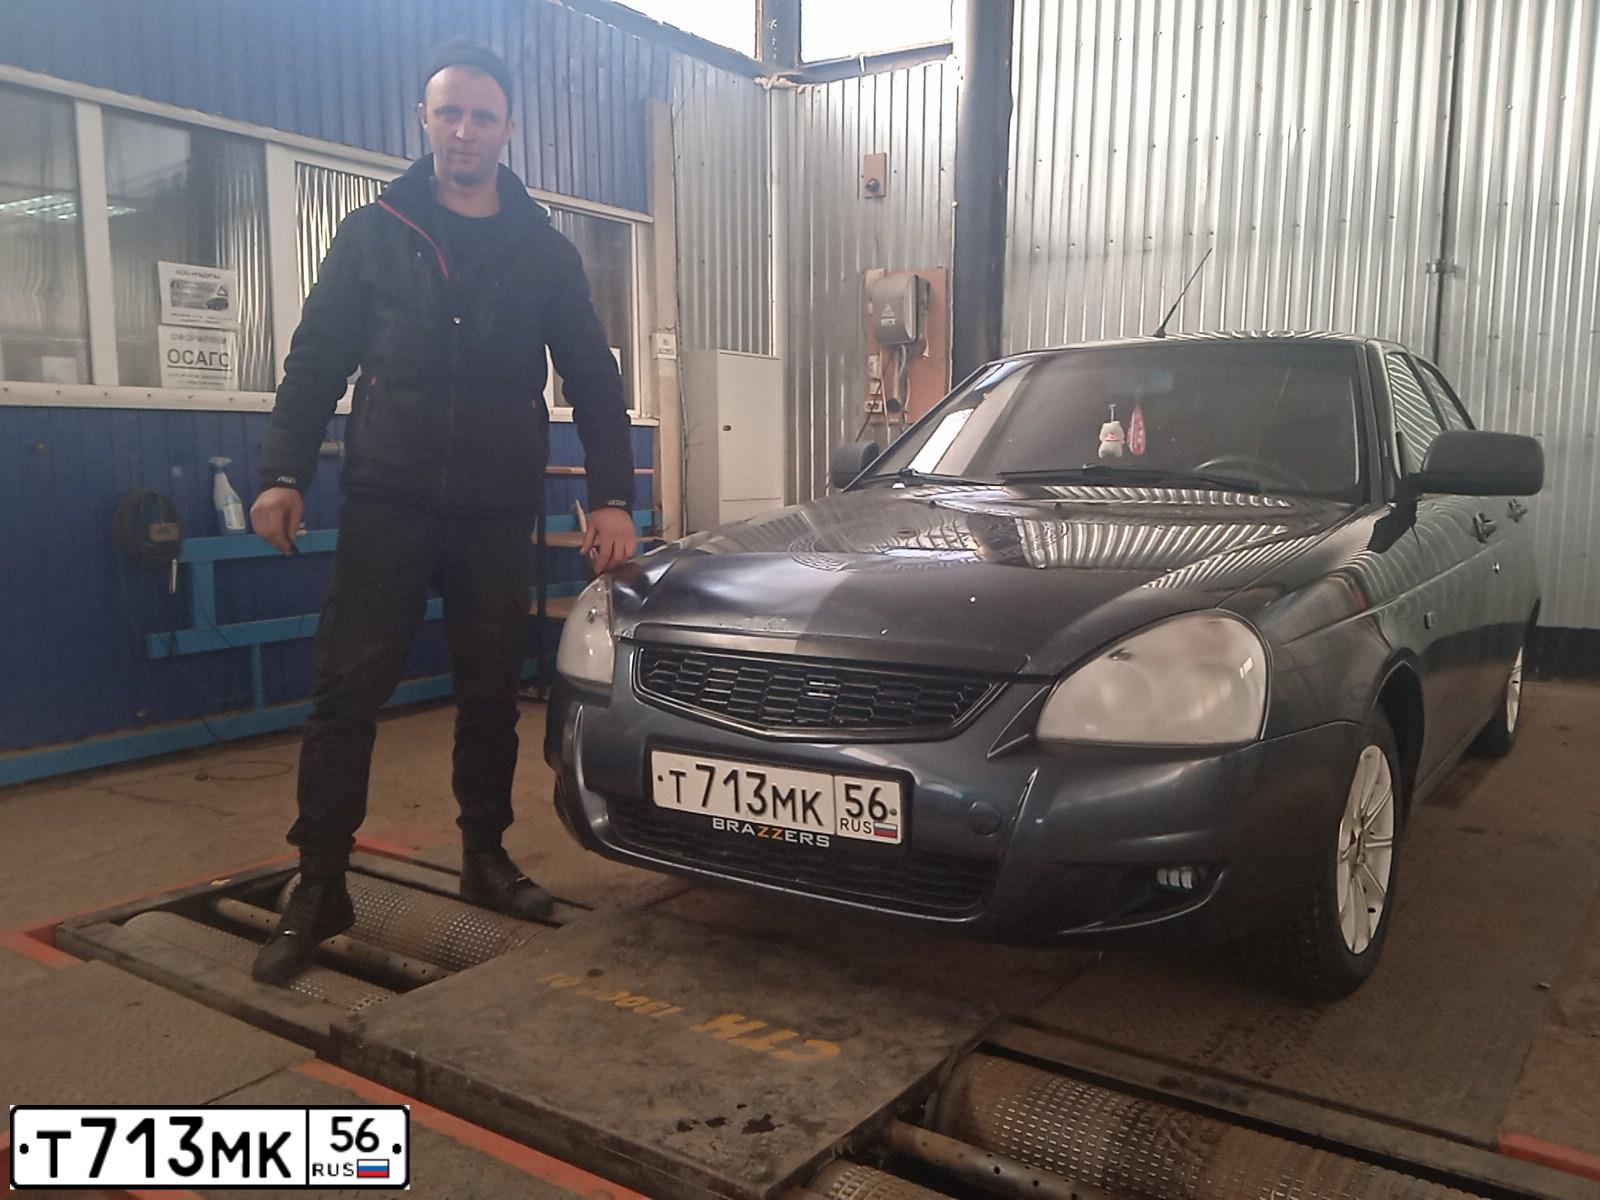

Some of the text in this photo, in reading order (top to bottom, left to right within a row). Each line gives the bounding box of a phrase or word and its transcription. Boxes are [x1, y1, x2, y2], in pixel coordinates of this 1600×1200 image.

[669, 764, 888, 827] Т713МК 56
[712, 818, 830, 848] BRAZZERS
[840, 818, 872, 834] RUS
